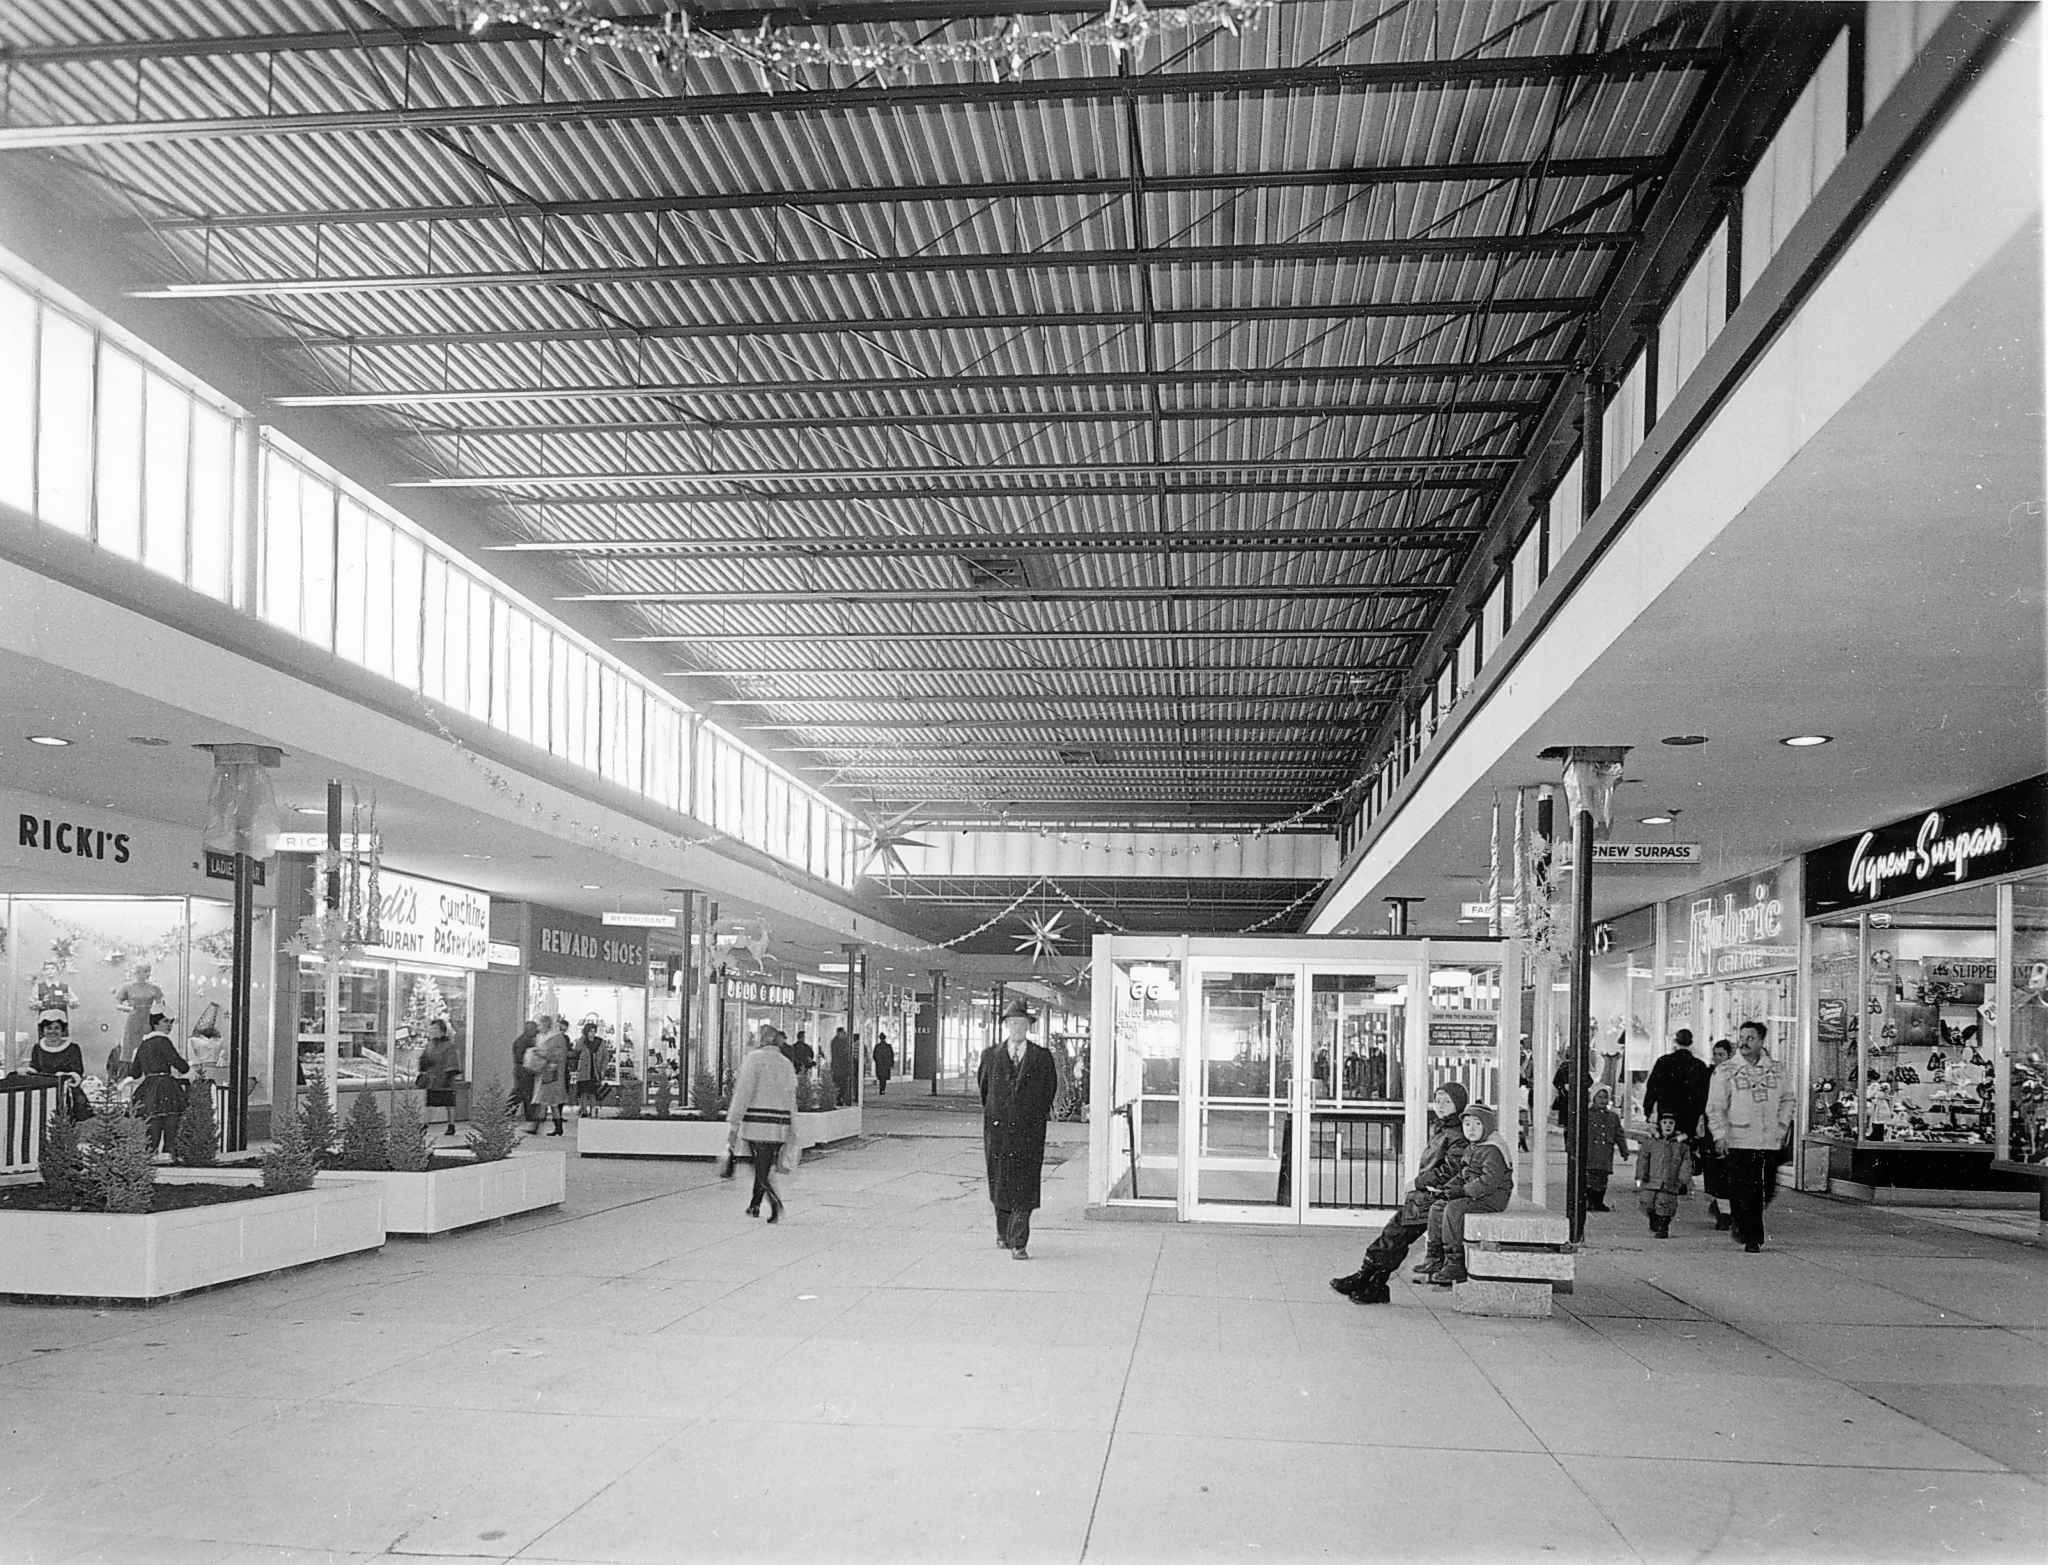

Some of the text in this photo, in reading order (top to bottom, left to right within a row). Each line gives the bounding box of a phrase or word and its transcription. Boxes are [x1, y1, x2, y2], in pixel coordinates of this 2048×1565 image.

[19, 814, 130, 863] RICKI'S
[1592, 846, 1691, 857] GNEW SURPASS
[1848, 811, 2002, 899] Agnew Surpass
[211, 858, 235, 876] LADIE
[541, 928, 598, 959] REWARD
[603, 940, 642, 966] SHOES
